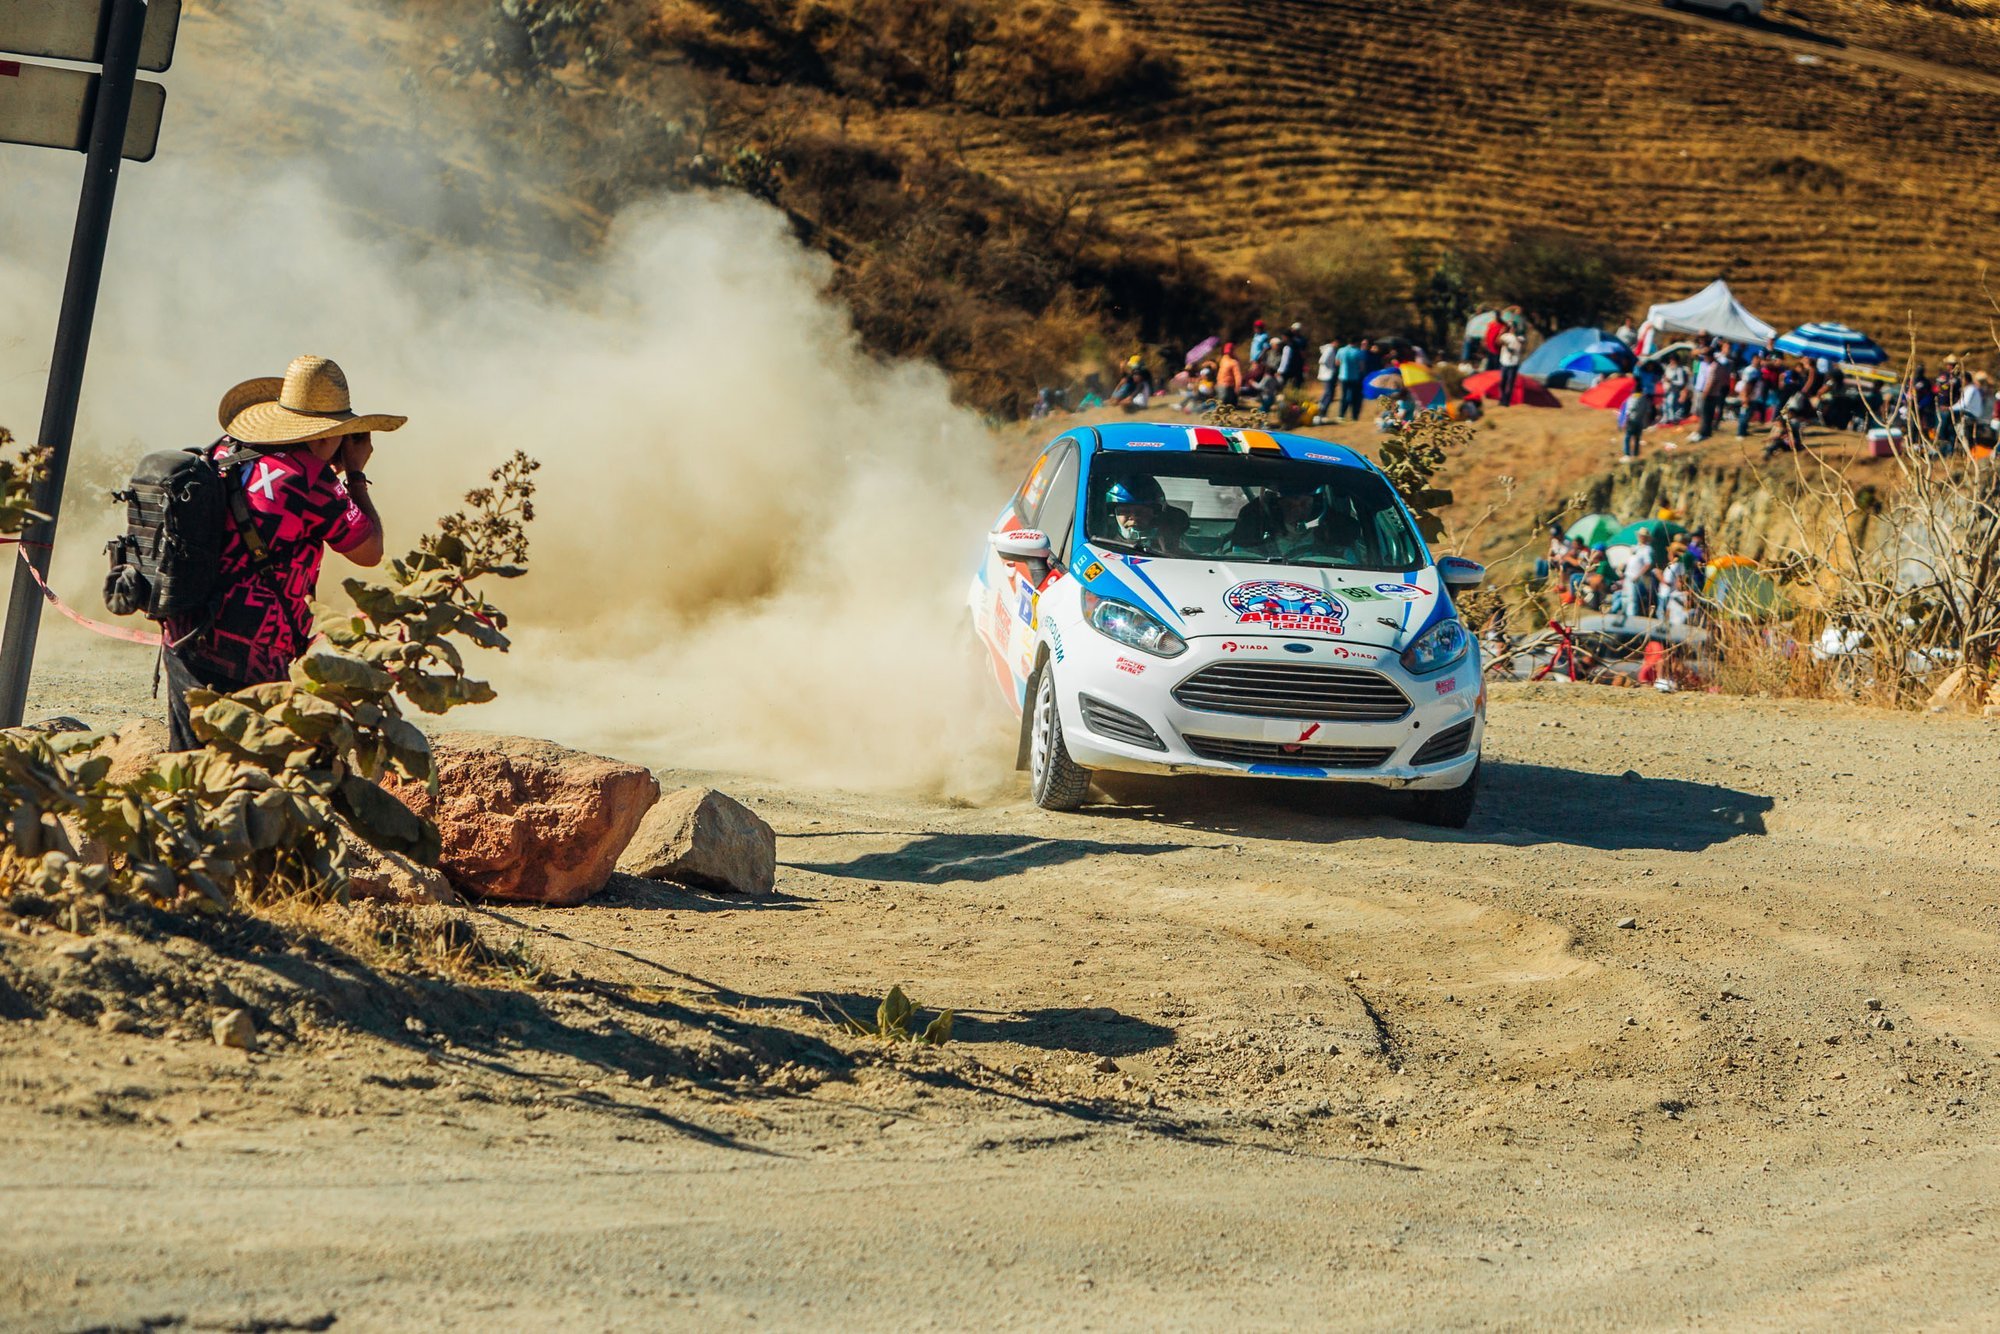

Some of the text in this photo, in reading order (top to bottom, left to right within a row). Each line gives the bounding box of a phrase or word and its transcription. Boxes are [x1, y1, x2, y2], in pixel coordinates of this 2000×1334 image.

[1239, 612, 1340, 625] ARCTIC
[1272, 622, 1342, 634] racing
[1351, 651, 1379, 661] VIADA
